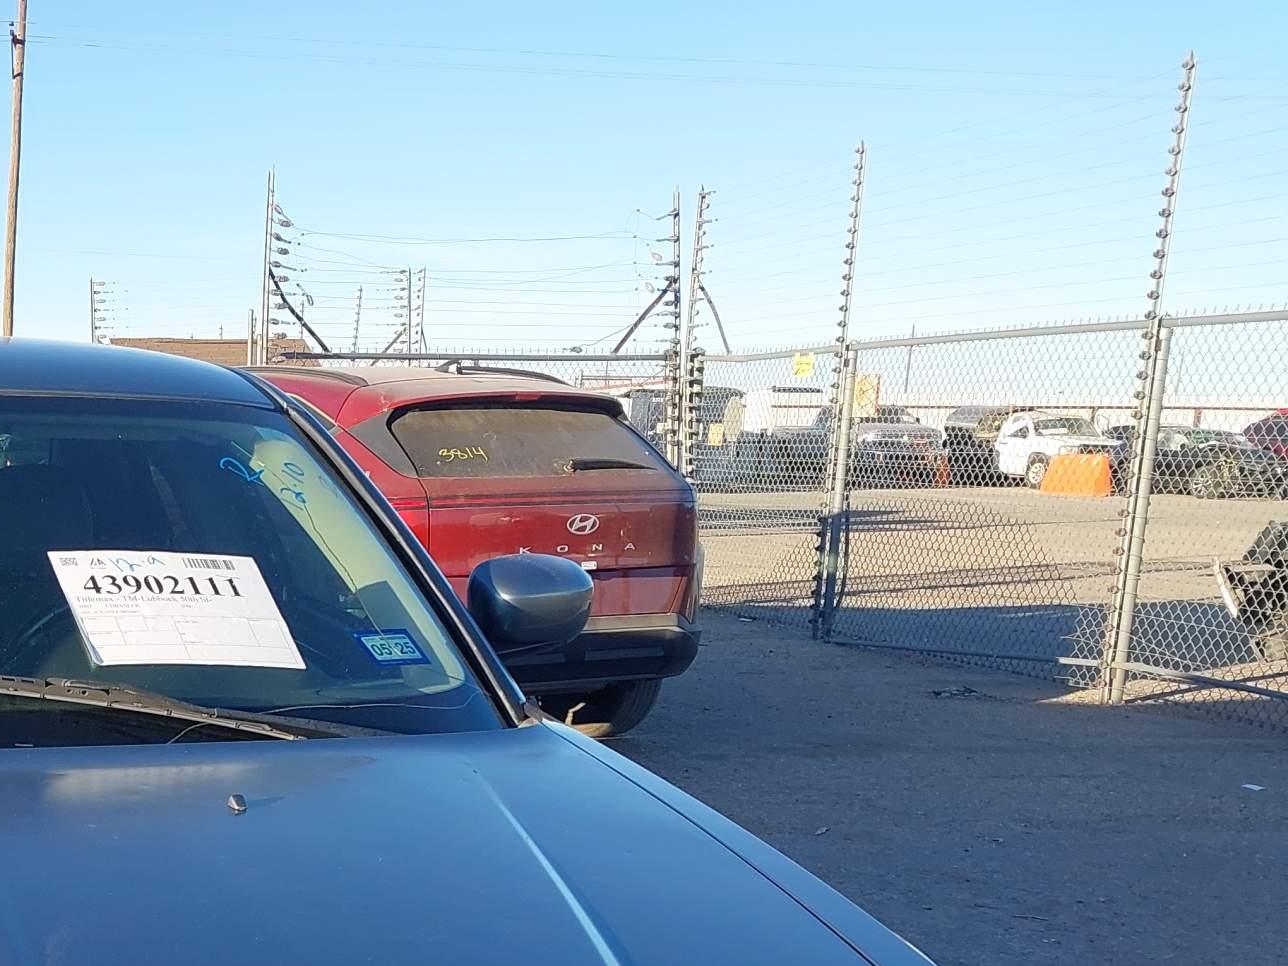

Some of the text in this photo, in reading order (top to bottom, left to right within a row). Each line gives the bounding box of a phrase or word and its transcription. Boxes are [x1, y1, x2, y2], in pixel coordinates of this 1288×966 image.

[438, 446, 488, 462] 3814
[519, 542, 636, 555] KONA
[83, 574, 248, 598] 43902111
[370, 643, 392, 657] 05
[394, 641, 417, 655] 25
